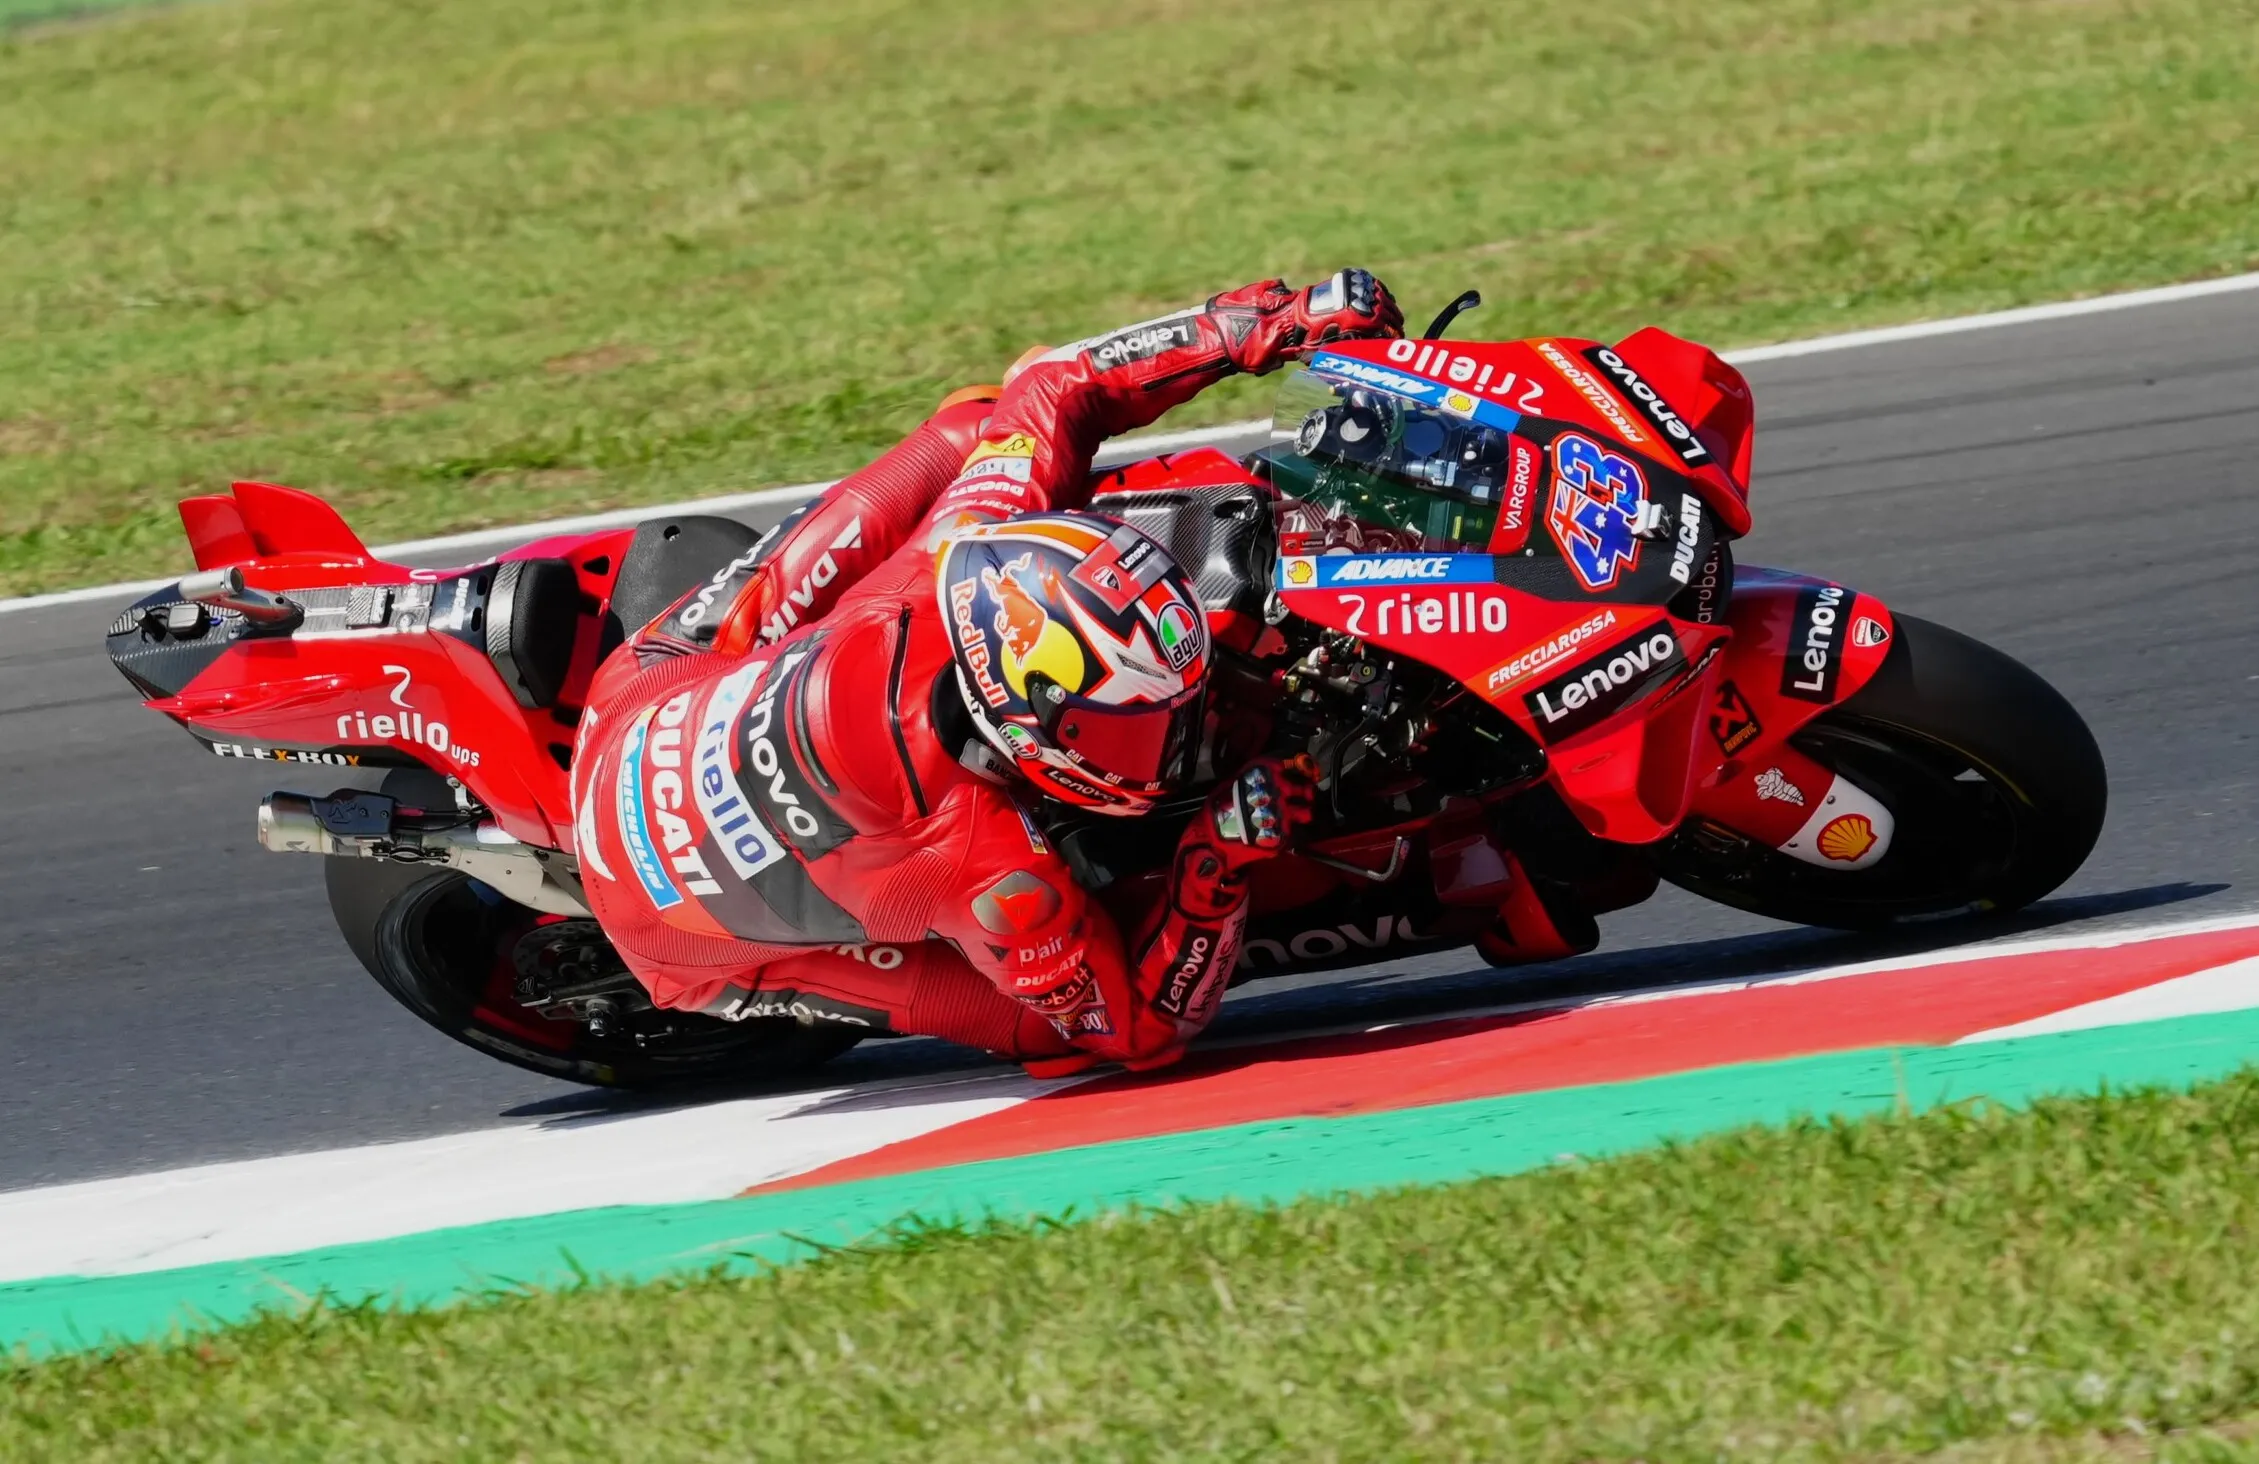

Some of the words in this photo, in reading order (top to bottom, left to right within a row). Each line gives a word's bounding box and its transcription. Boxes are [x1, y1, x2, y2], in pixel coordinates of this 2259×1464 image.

[1099, 324, 1189, 363] Lenovo
[1386, 338, 1517, 396] riello
[1315, 357, 1434, 395] ADVANCE
[1537, 342, 1644, 443] FRECCIAROSSA
[1598, 348, 1706, 462] Lenovo
[1118, 542, 1151, 570] Lenovo
[1670, 493, 1701, 584] DUCATI
[1331, 556, 1453, 581] ADVANCE
[1377, 592, 1507, 635] riello
[1794, 587, 1843, 691] Lenovo
[951, 577, 985, 648] Red
[968, 641, 1010, 708] Bull
[1172, 629, 1200, 663] agv
[1488, 610, 1616, 691] FRECCIAROSSA
[1535, 632, 1676, 724] Lenovo
[212, 742, 360, 767] FLEX-BOX
[336, 711, 449, 753] riello
[450, 744, 481, 768] ups
[1066, 749, 1085, 764] CAT
[650, 691, 724, 897] DUCATI
[701, 720, 768, 866] riello
[1048, 770, 1116, 802] Lenovo
[1104, 772, 1124, 785] CAT
[1145, 781, 1161, 792] CAT
[623, 760, 664, 889] MICHELIN
[1015, 948, 1084, 987] DUCATI
[1160, 936, 1208, 1014] Lenovo
